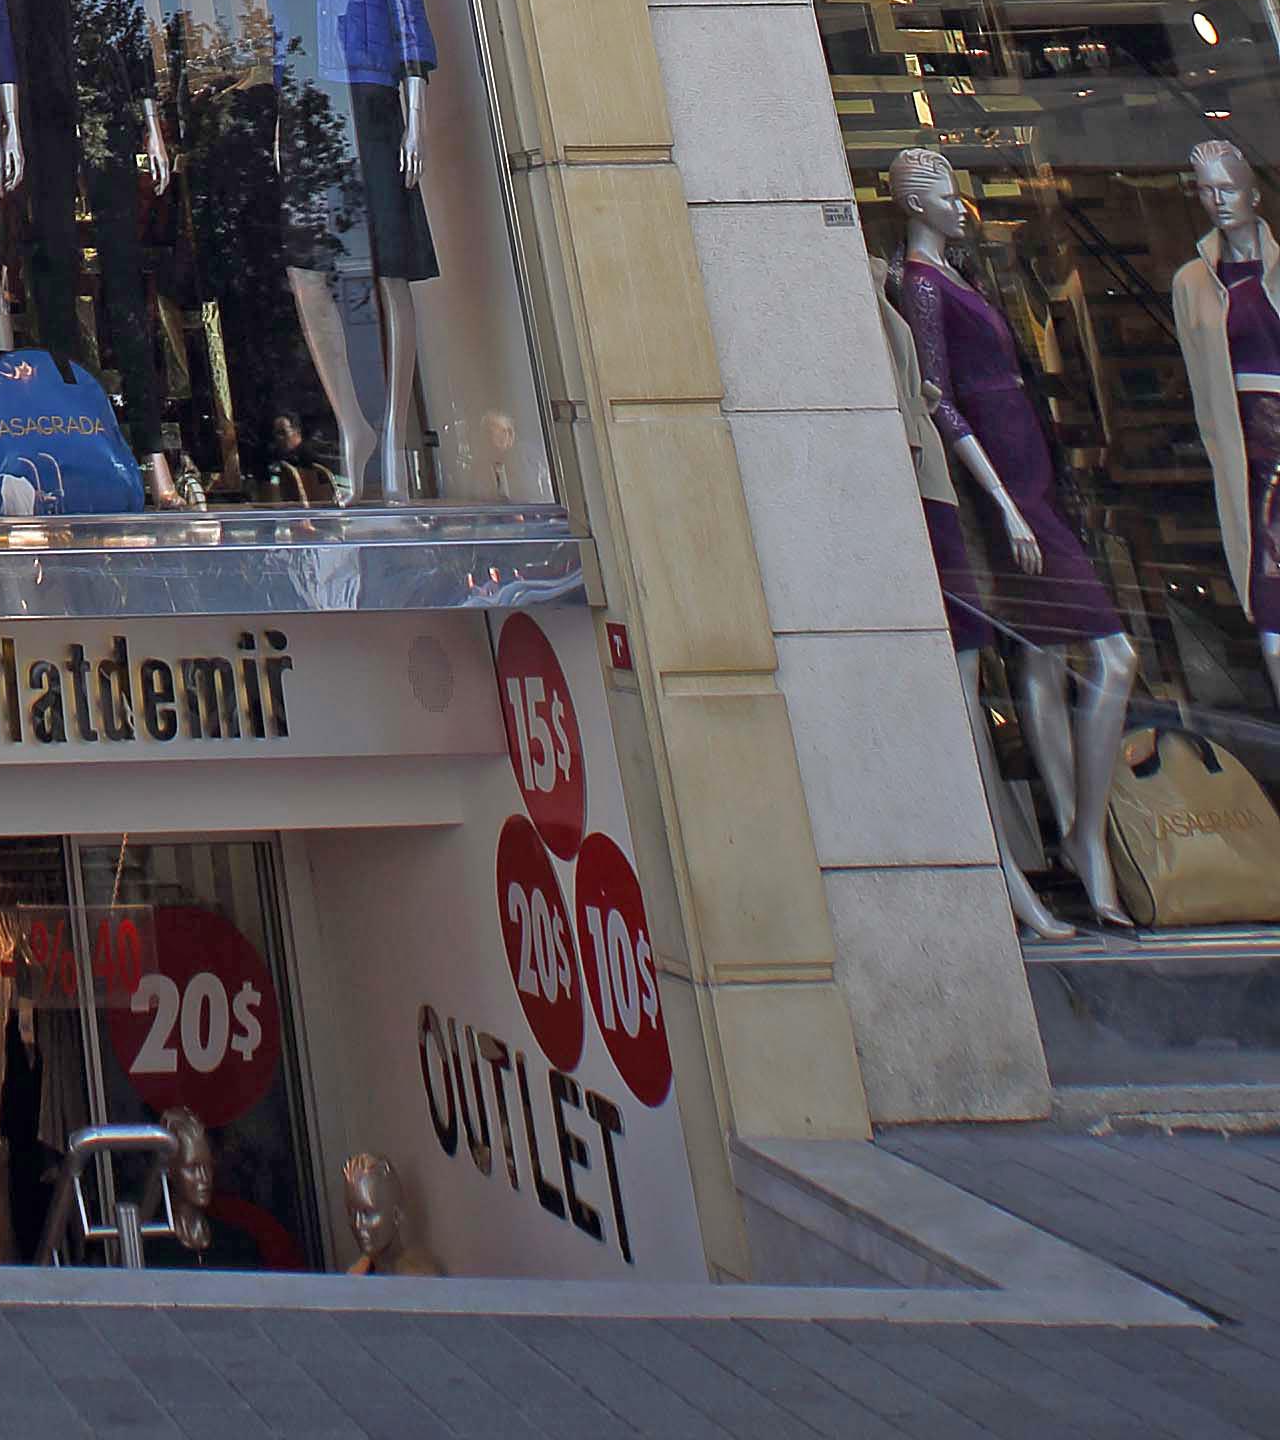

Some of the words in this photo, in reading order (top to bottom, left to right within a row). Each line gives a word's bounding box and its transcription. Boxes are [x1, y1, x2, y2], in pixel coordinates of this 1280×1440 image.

[506, 674, 571, 794] 15$
[507, 880, 574, 1005] 20$
[586, 904, 660, 1039] 10$
[129, 972, 263, 1075] 20$
[416, 1003, 635, 1266] OUTLET
